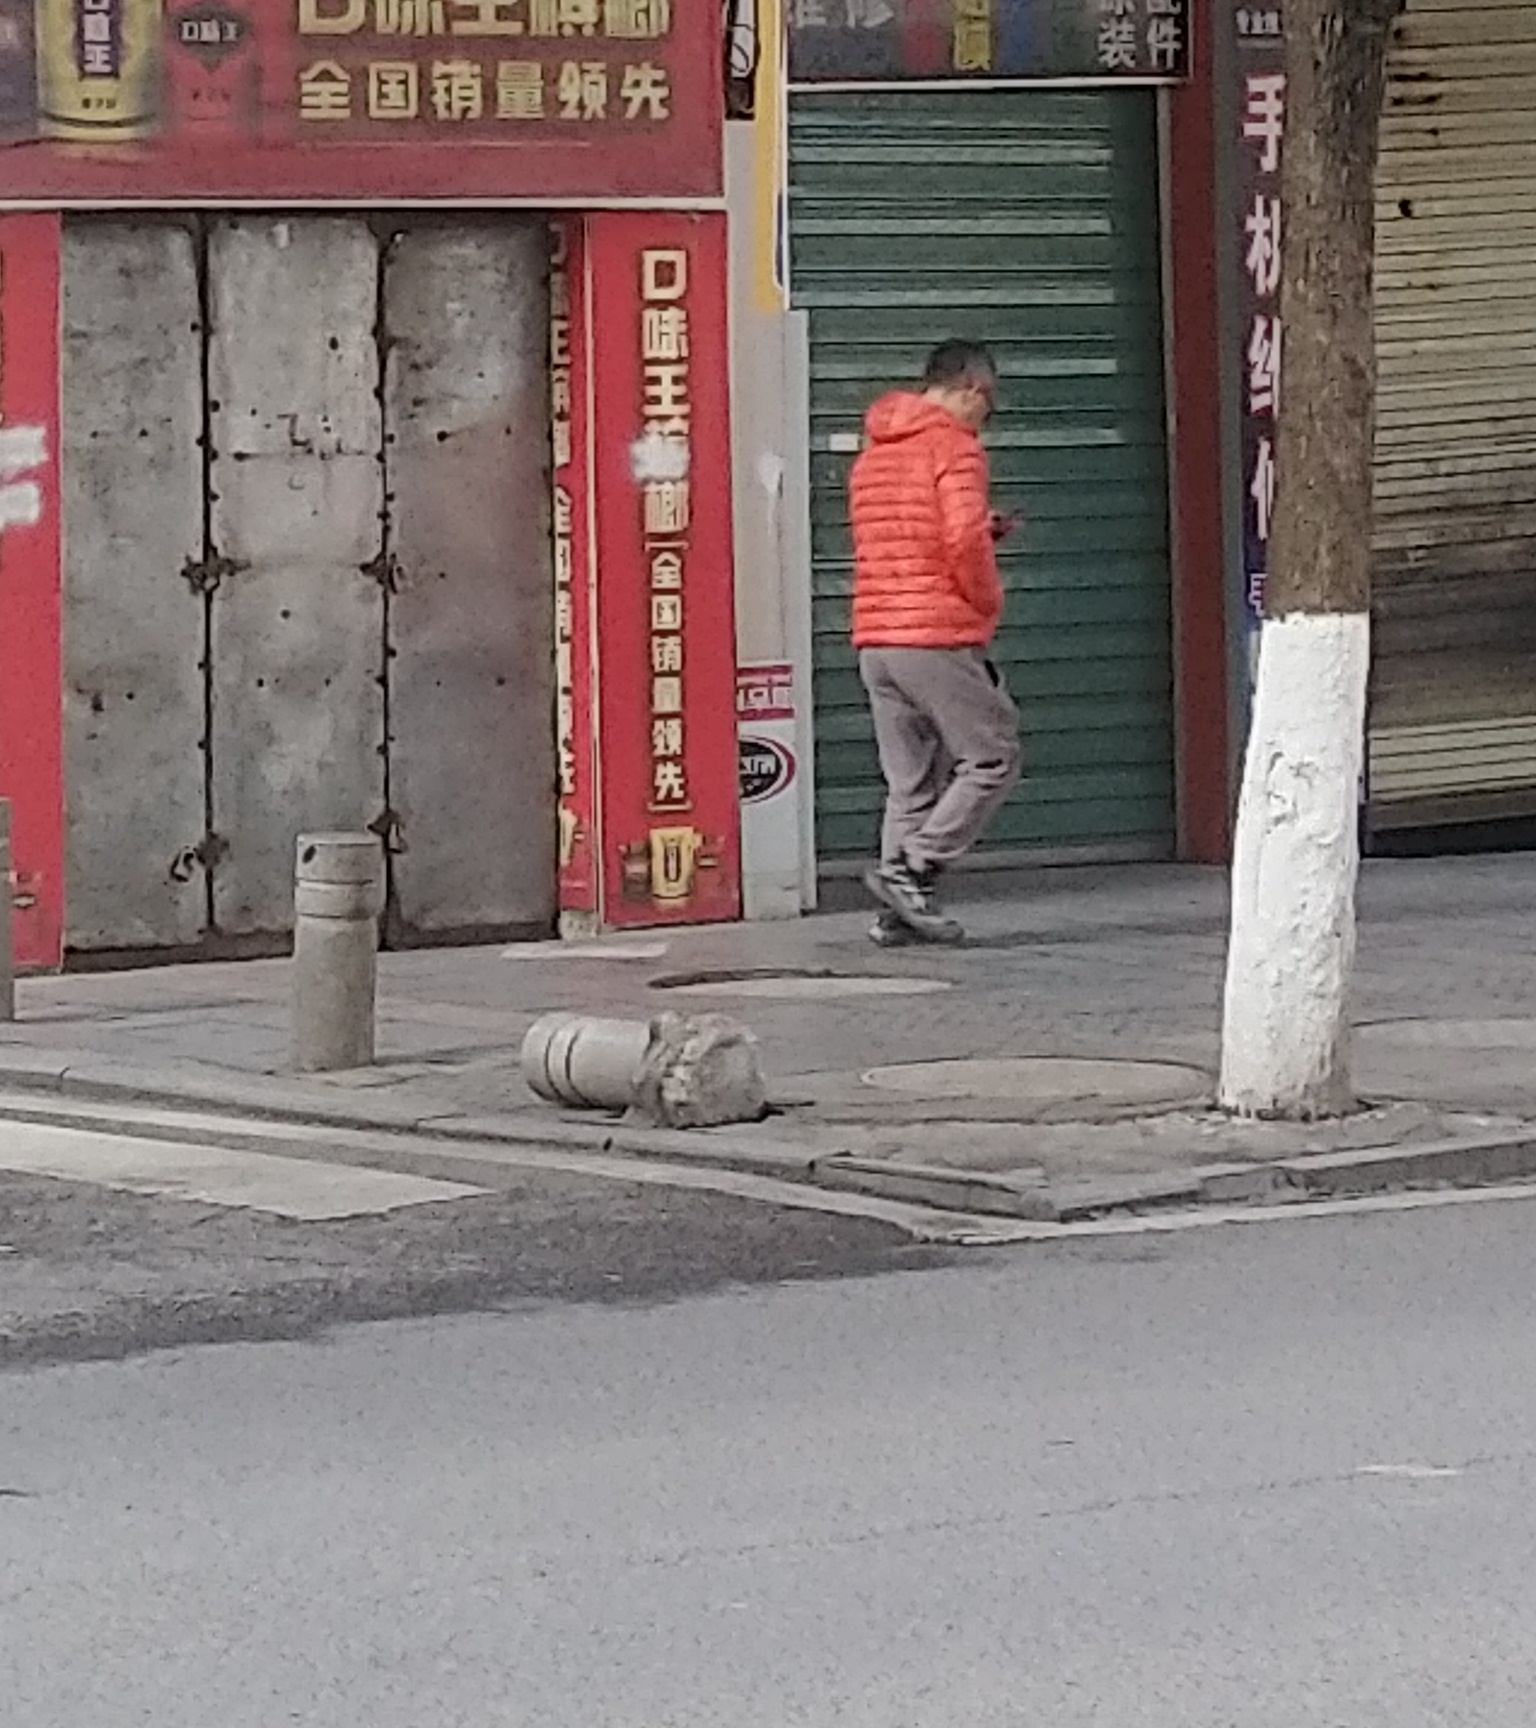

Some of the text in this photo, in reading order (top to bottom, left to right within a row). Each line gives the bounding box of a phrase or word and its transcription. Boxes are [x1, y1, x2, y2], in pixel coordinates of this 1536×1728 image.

[299, 59, 670, 122] 全国销量领先
[641, 248, 690, 535] 口味王榔
